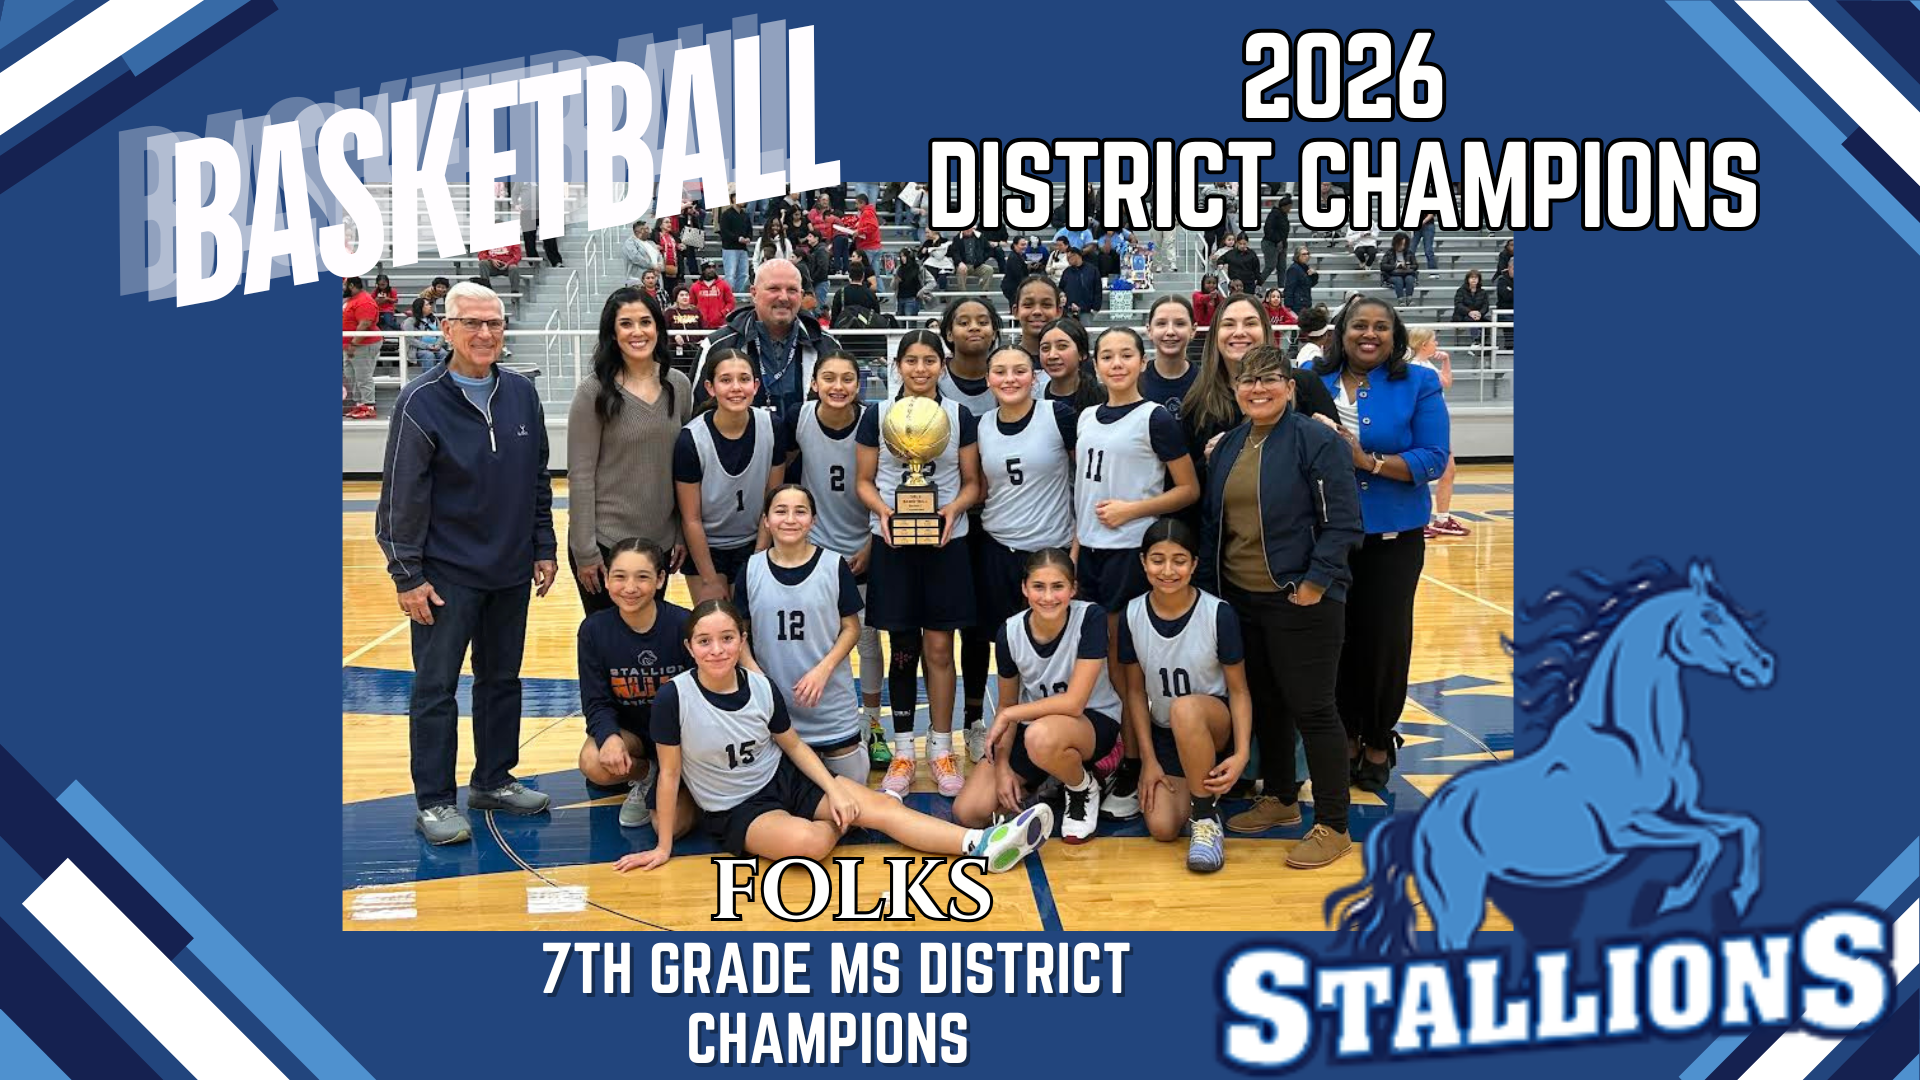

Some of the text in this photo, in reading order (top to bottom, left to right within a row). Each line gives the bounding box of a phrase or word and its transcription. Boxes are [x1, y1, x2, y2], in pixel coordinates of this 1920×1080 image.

[829, 464, 845, 492] 2
[1005, 457, 1023, 486] 5
[1086, 447, 1104, 482] 11
[736, 489, 745, 512] 1
[777, 610, 805, 641] 12
[1158, 667, 1192, 698] 10
[725, 739, 756, 770] 15
